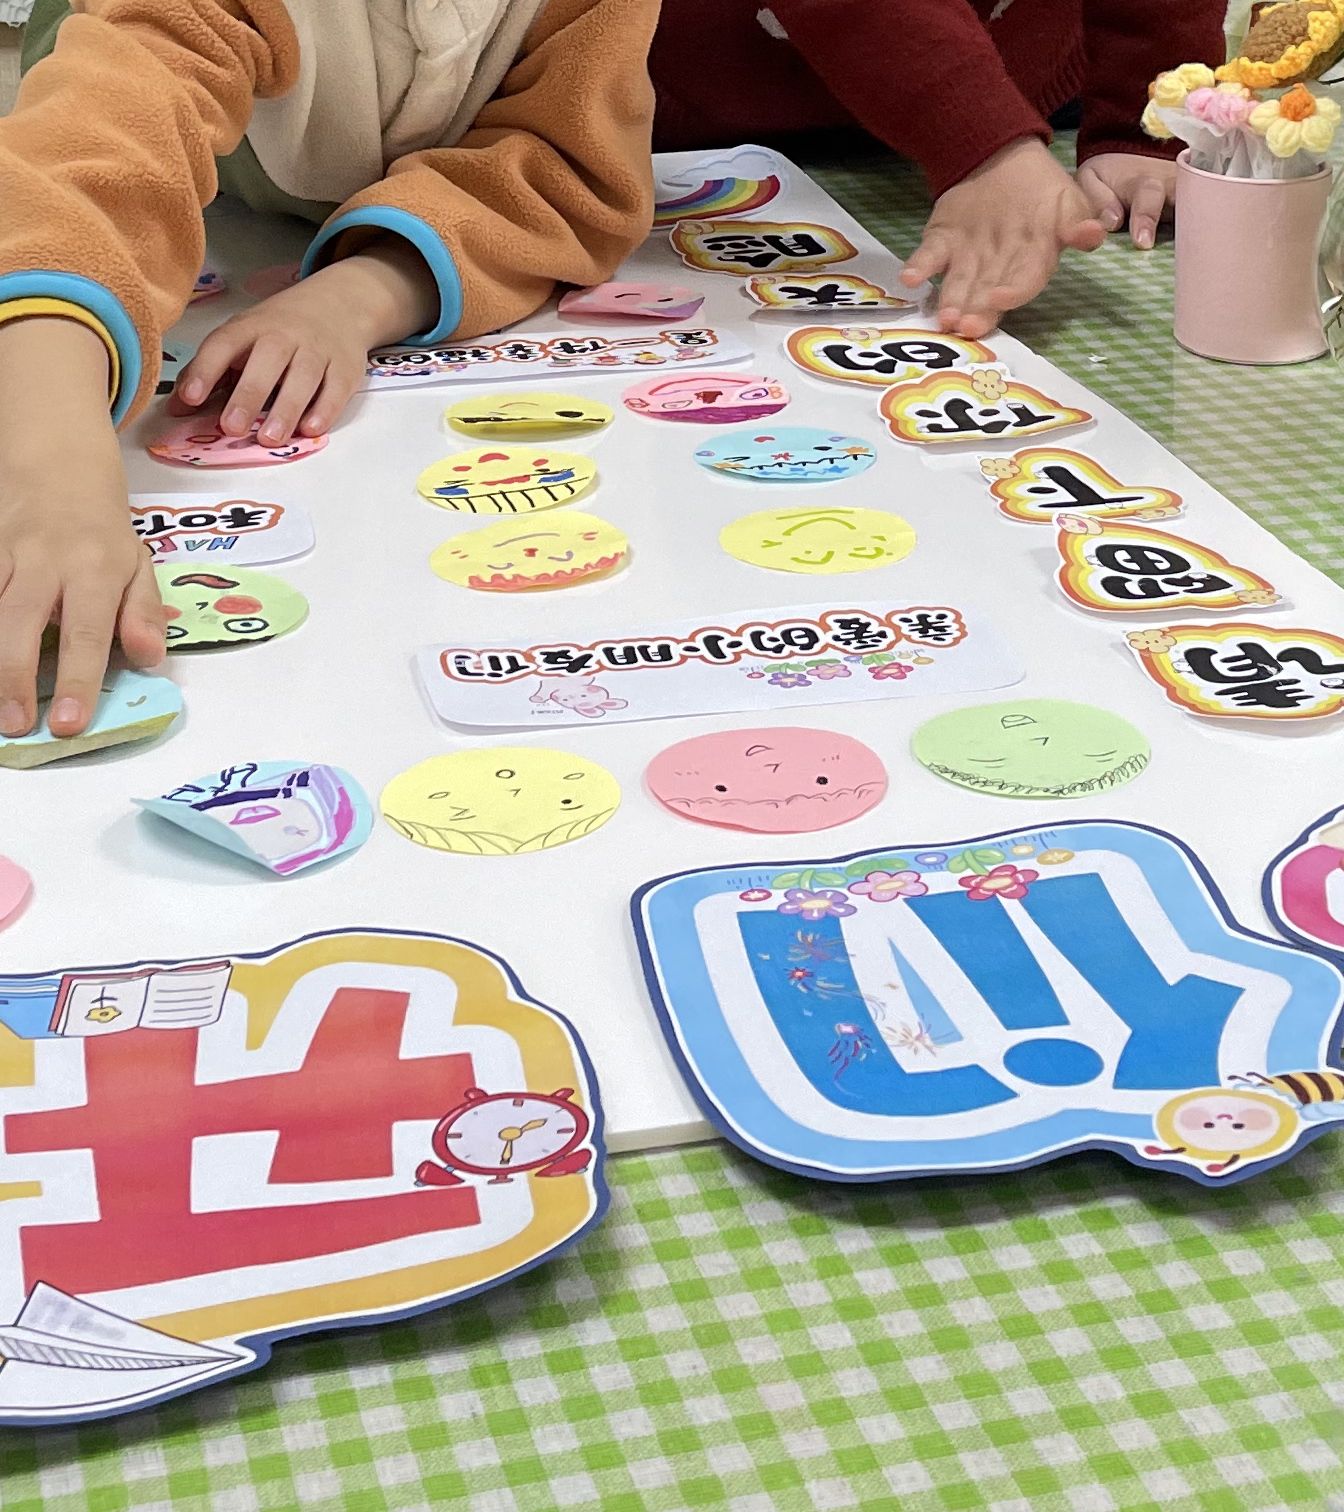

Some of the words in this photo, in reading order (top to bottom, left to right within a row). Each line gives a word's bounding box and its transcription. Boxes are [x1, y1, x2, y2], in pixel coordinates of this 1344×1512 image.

[443, 611, 956, 678] 亲爱的小朋友们
